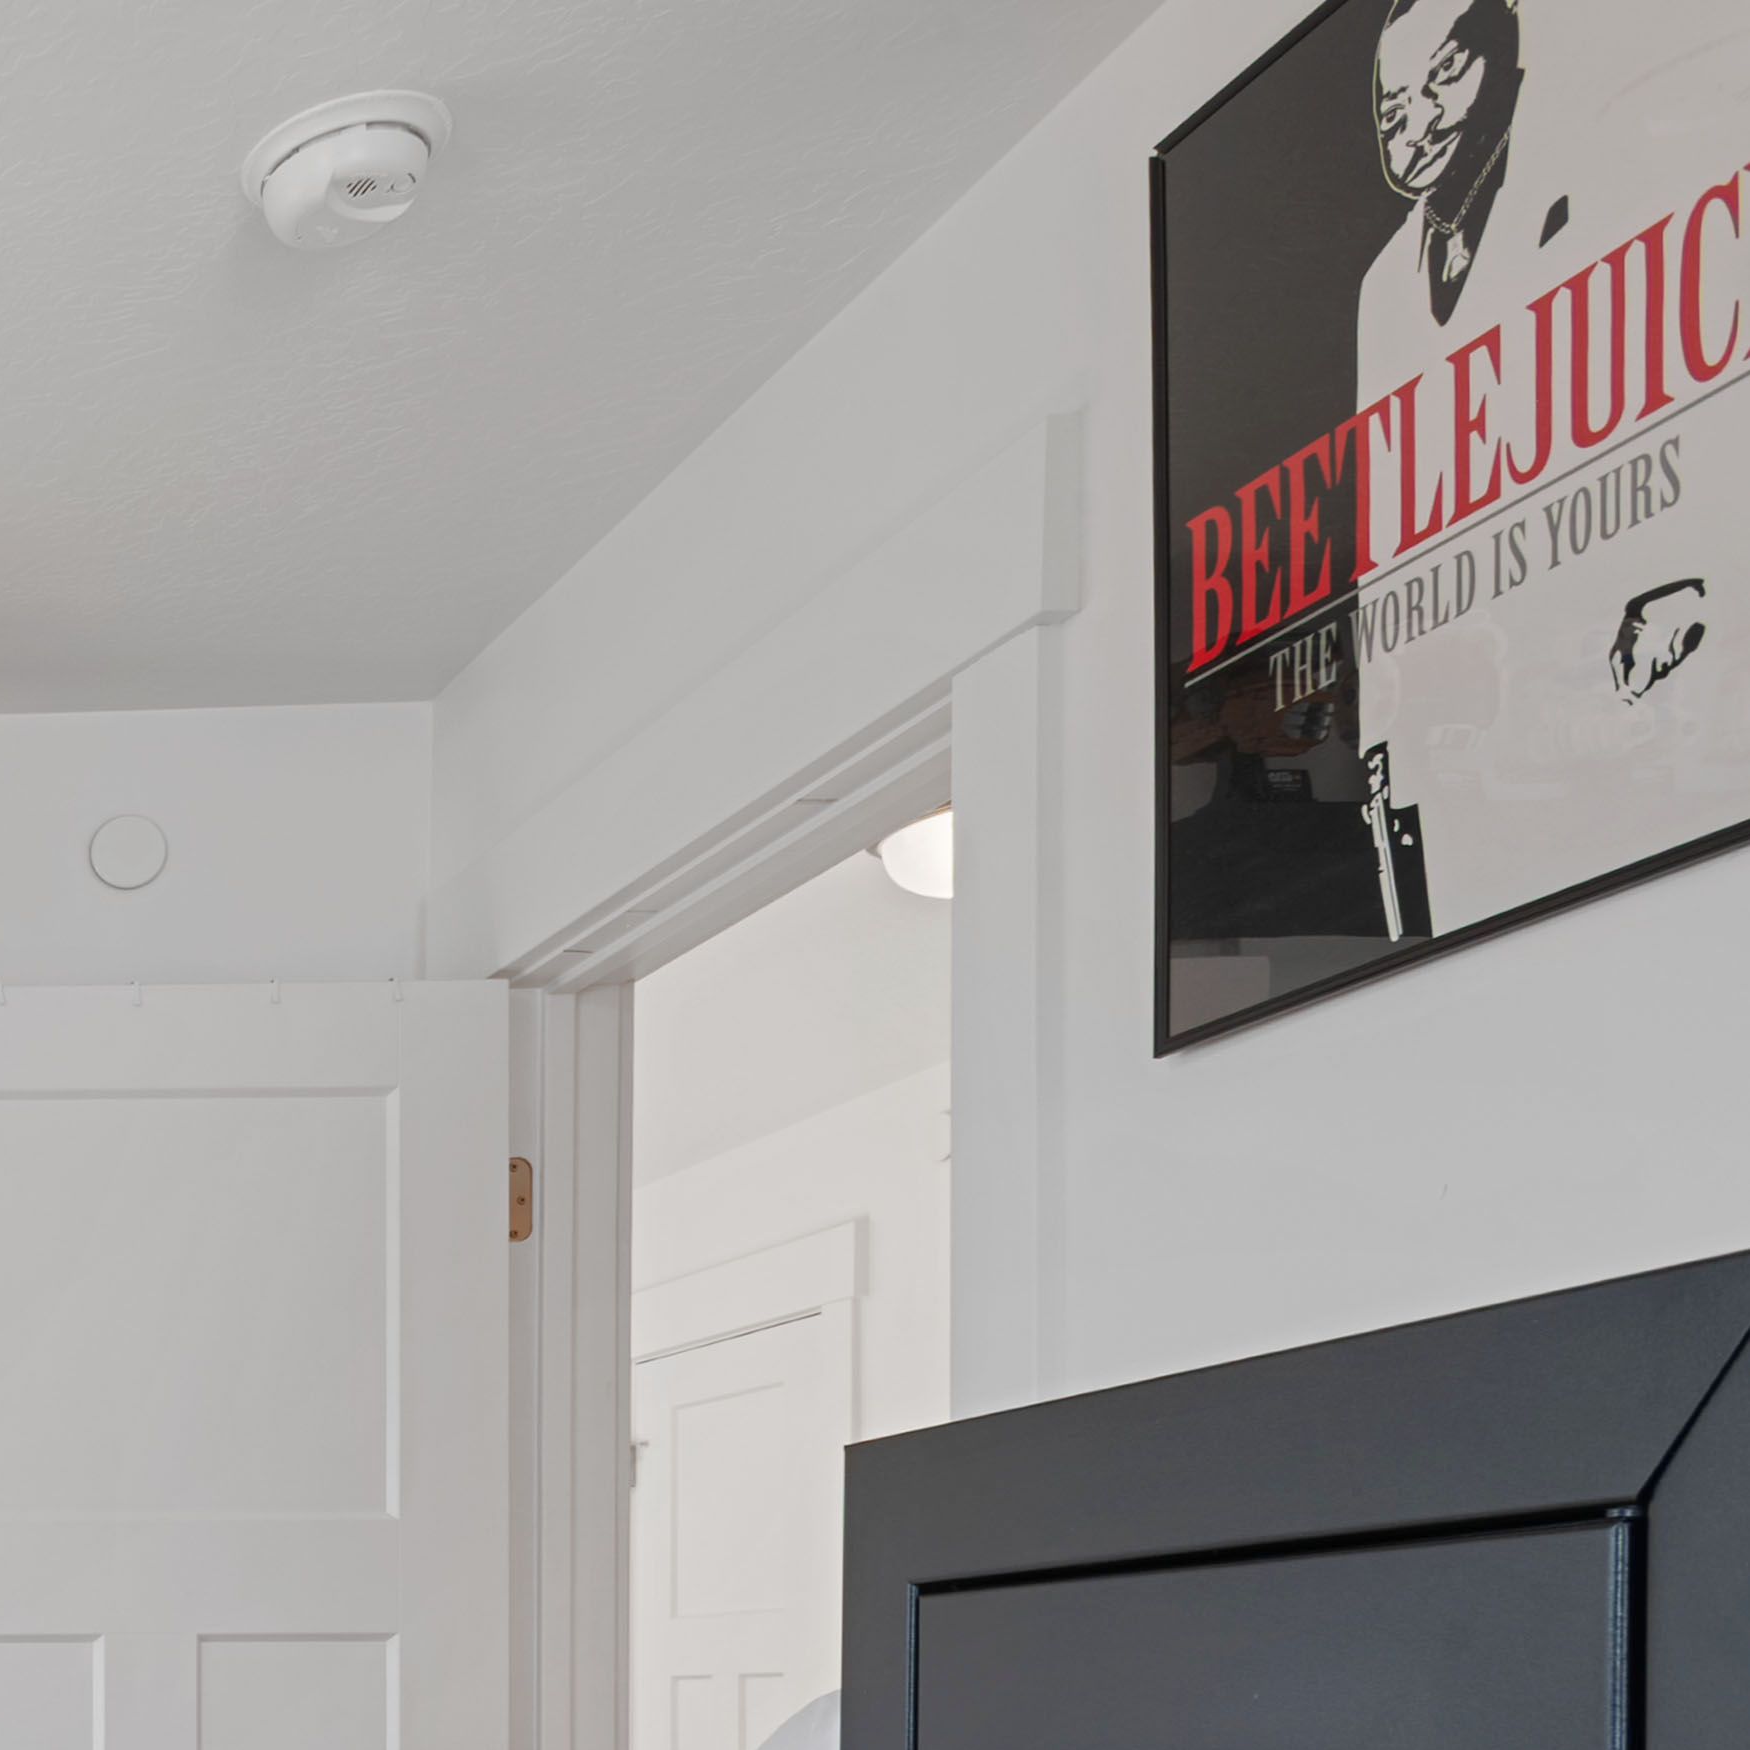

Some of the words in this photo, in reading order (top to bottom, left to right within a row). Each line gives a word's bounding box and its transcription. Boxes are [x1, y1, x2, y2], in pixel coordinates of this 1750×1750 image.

[1186, 163, 1750, 674] BEETLEJUIC
[1268, 621, 1338, 712] THE
[1348, 549, 1477, 671] WORLD
[1490, 516, 1528, 600] IS
[1541, 434, 1682, 572] YOURS
